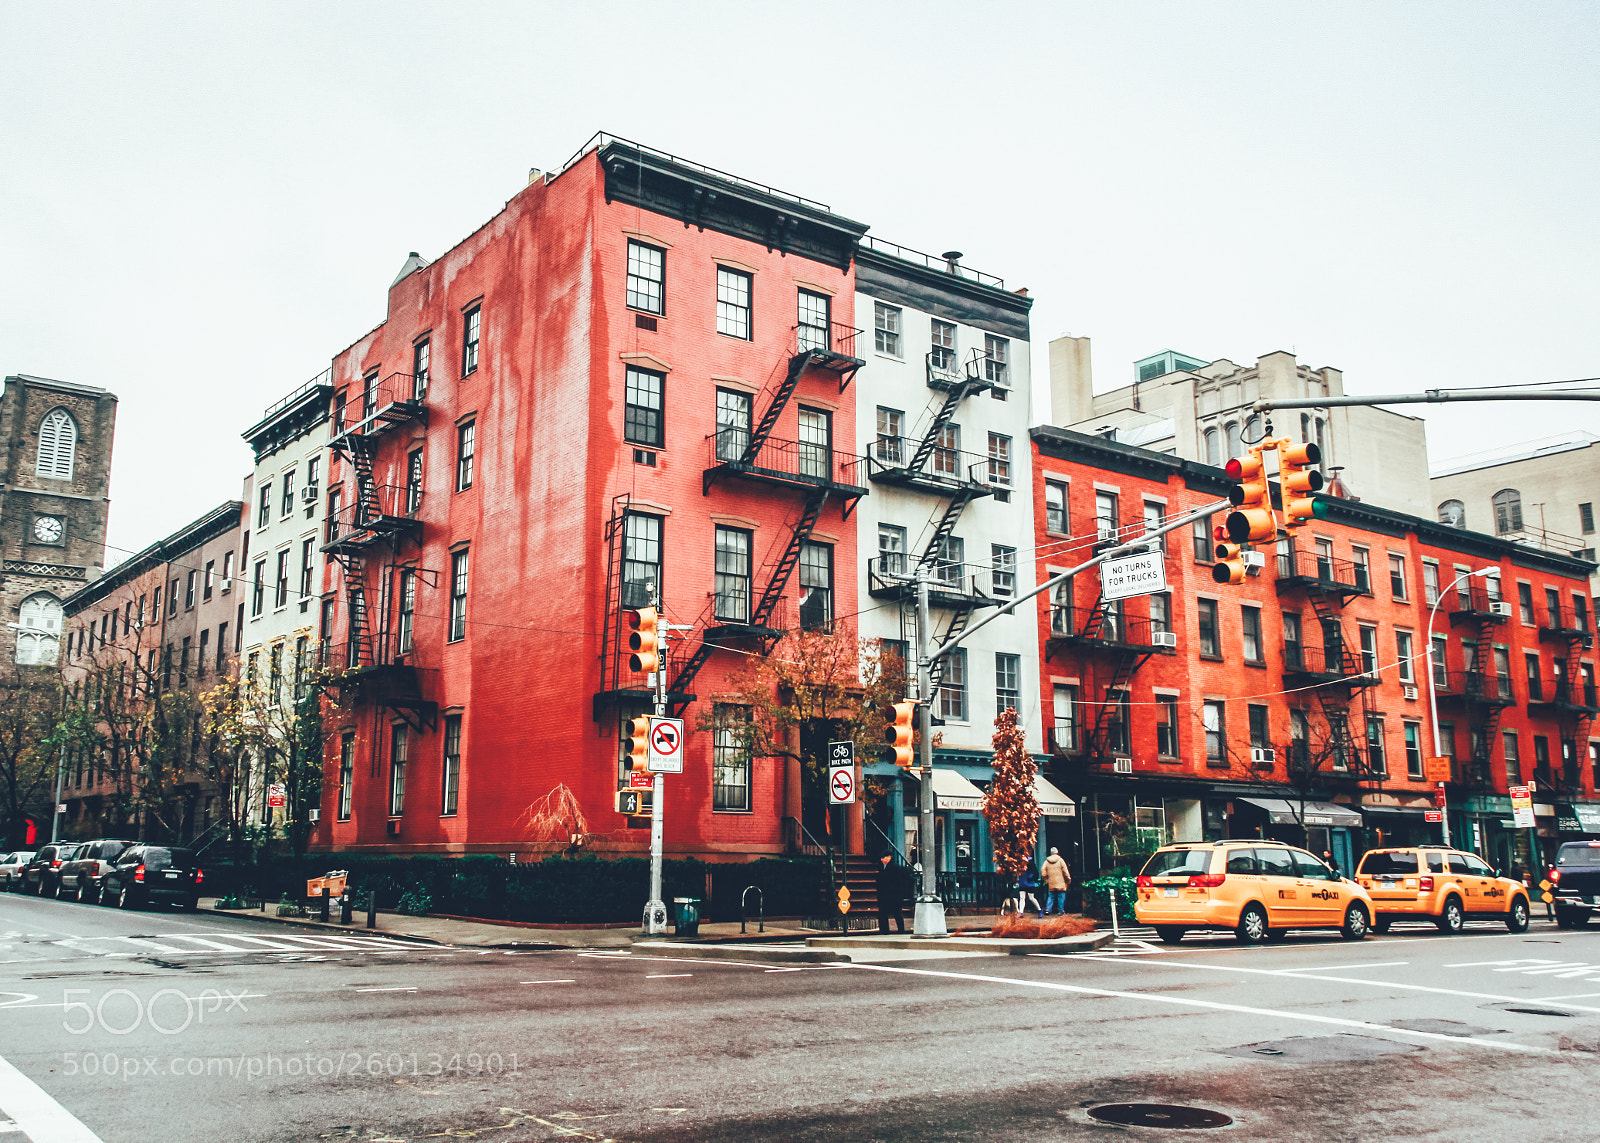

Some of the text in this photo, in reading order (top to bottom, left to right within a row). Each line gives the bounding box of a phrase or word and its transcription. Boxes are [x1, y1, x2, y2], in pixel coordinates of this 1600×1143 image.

[1112, 560, 1152, 575] NO TURNS
[1108, 570, 1158, 586] FOR TRUCKS
